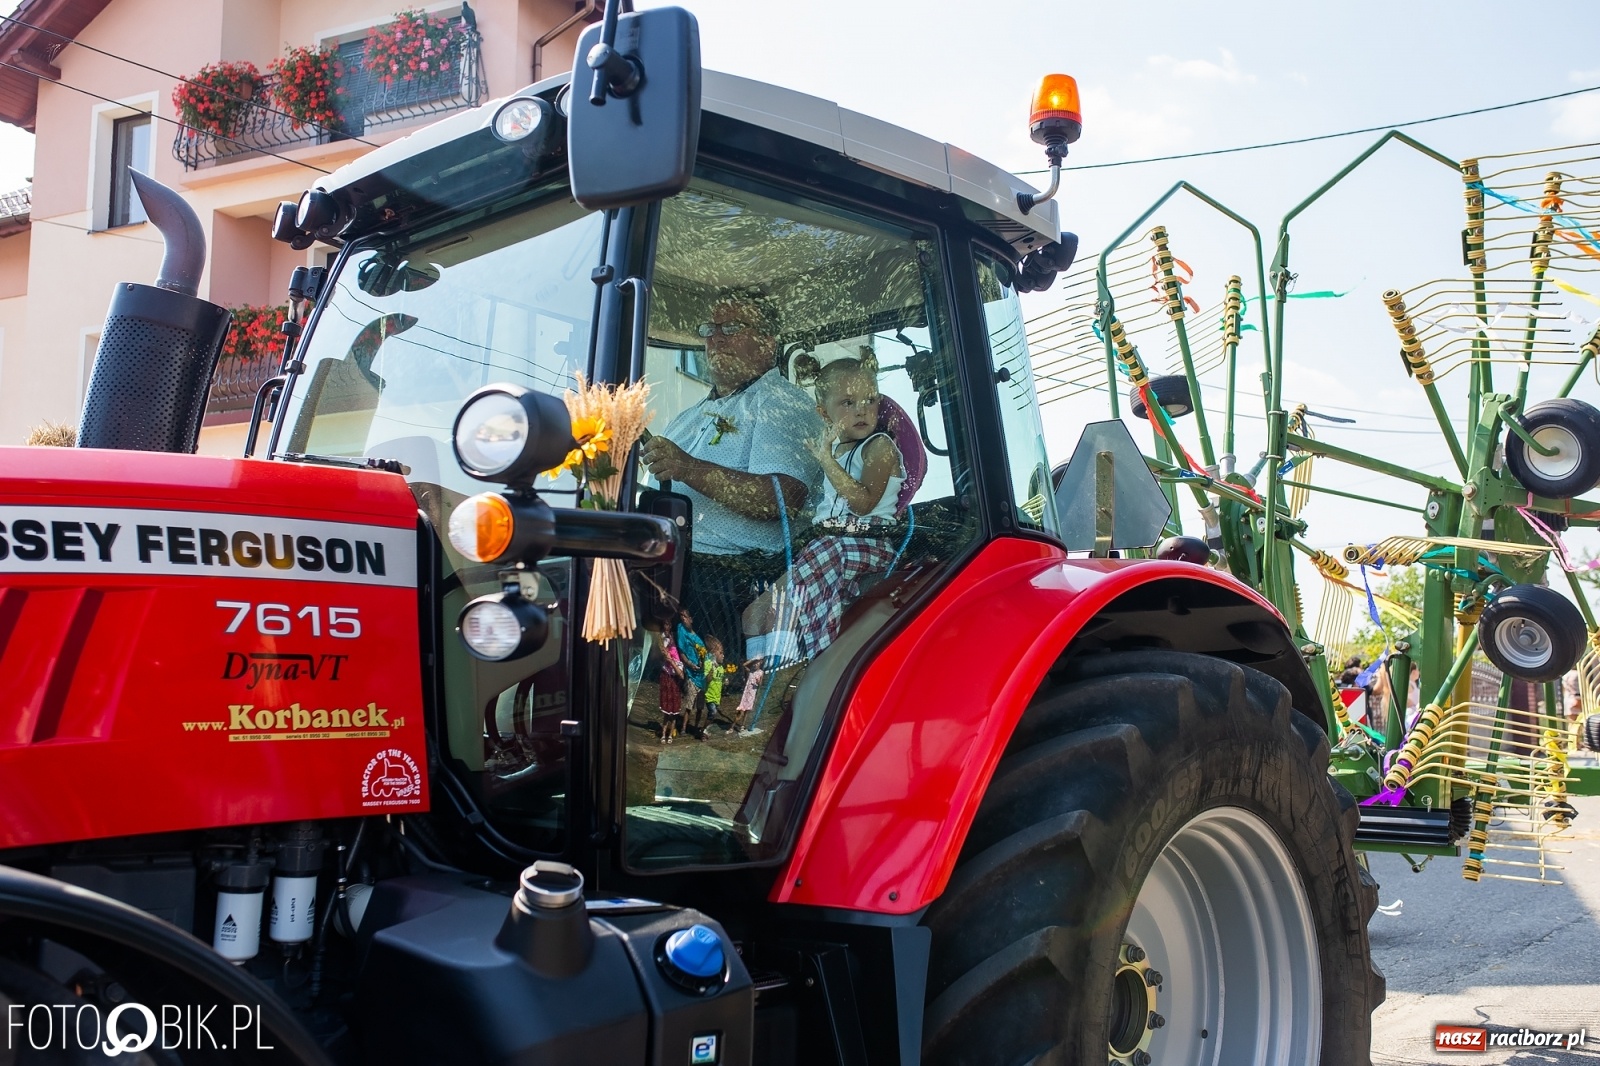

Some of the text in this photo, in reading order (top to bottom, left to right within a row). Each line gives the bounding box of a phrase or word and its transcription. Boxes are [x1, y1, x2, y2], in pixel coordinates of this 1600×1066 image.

[0, 519, 386, 576] SEY FERGUSON
[216, 601, 361, 638] 7615
[220, 652, 348, 690] Dyna-VT
[182, 703, 405, 731] www.Korbanek.pl
[362, 758, 377, 797] TRACTOR
[376, 750, 386, 760] OF
[388, 749, 402, 758] THE
